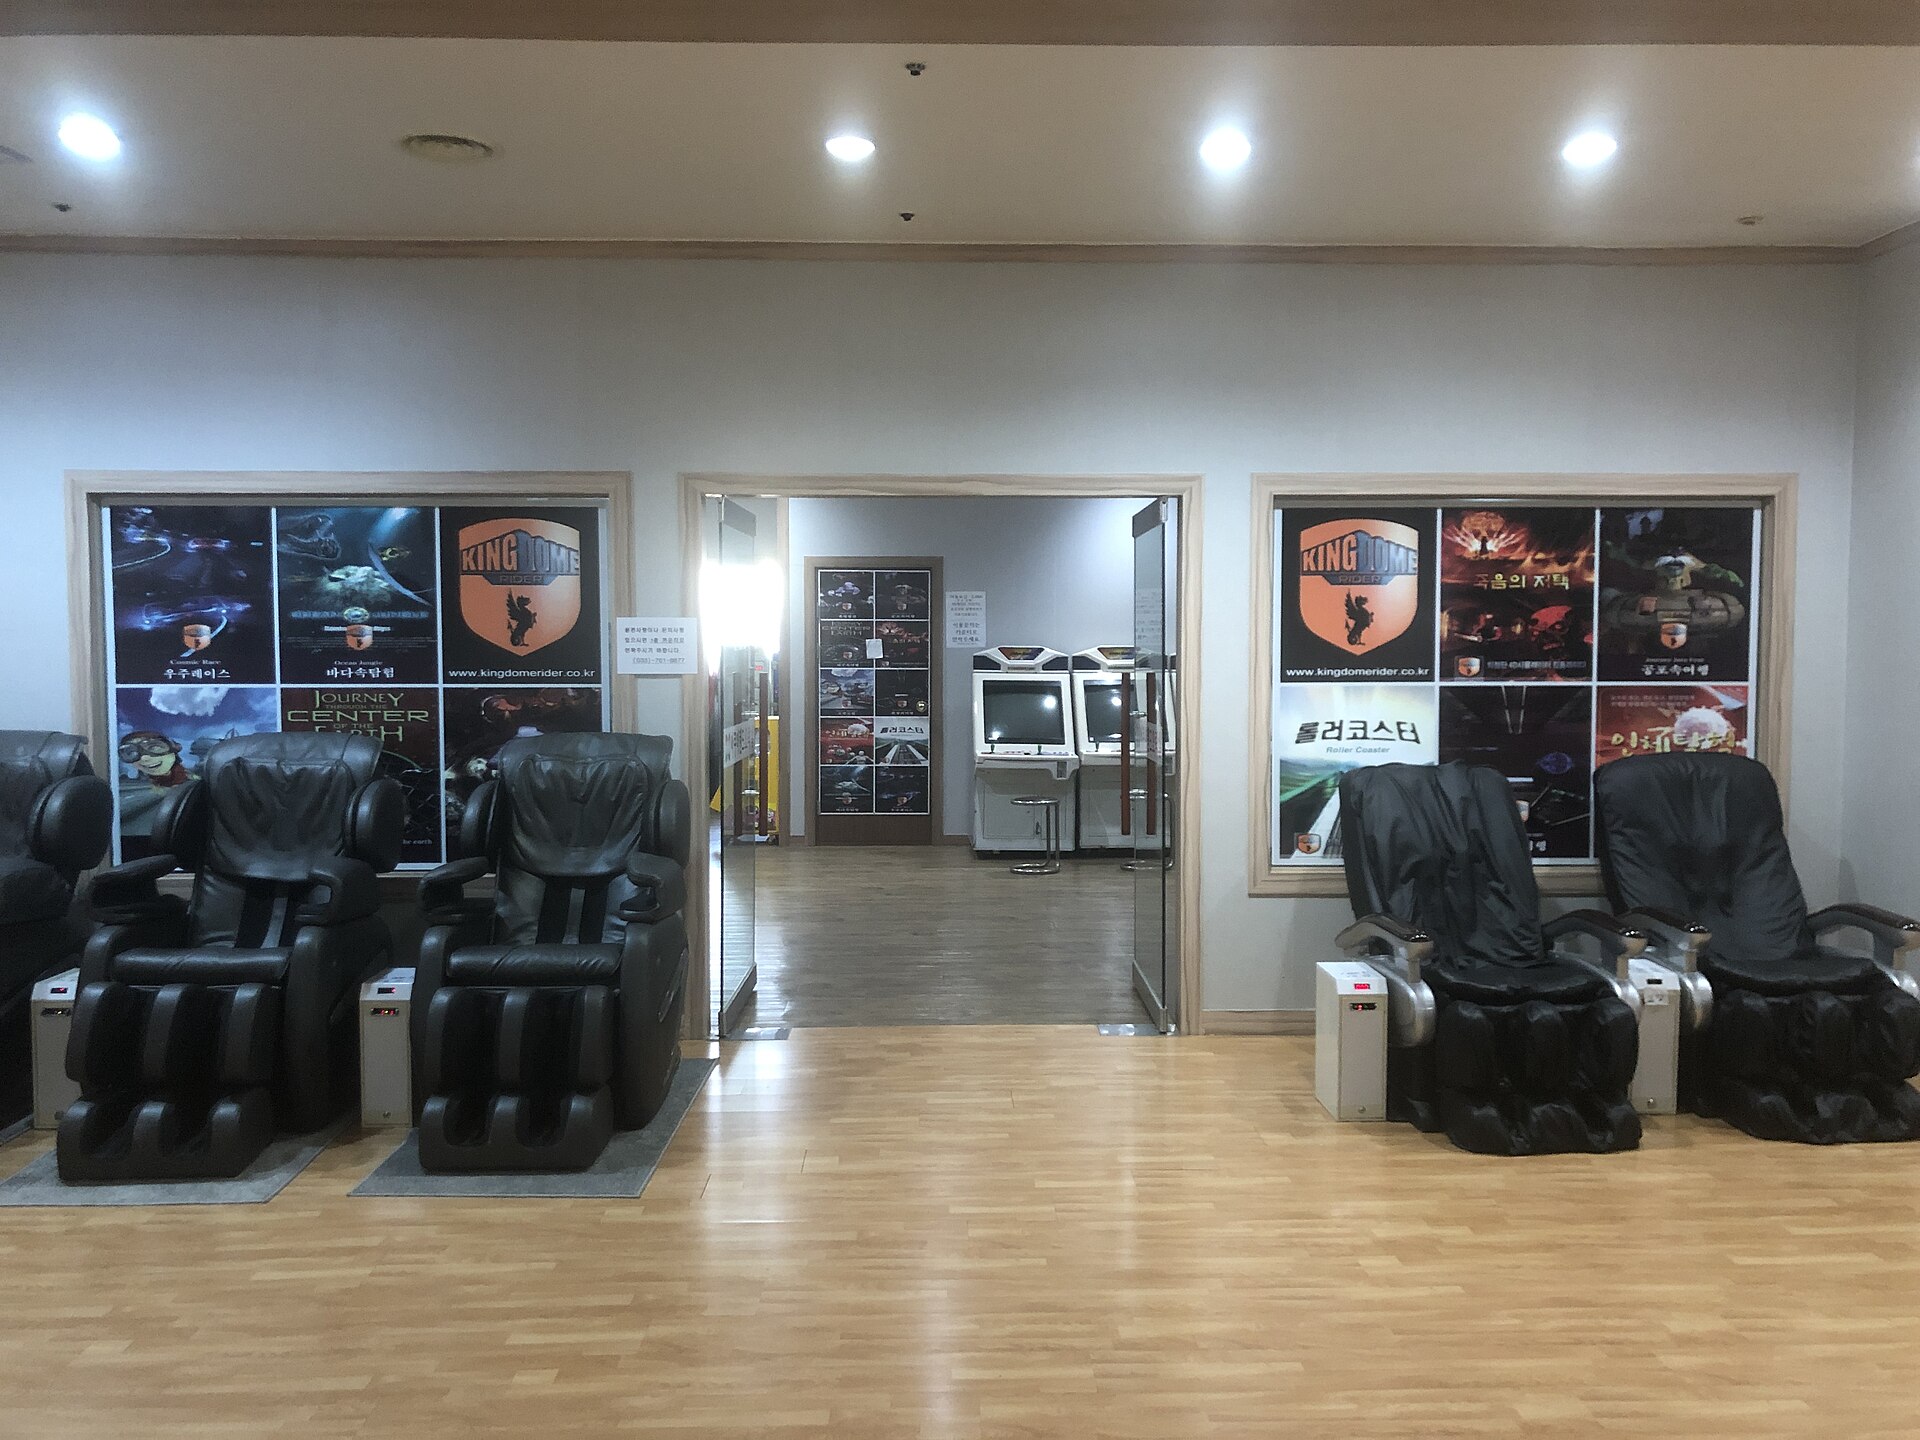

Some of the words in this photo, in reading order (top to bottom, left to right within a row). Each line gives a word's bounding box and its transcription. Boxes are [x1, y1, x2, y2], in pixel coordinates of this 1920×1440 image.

[462, 531, 579, 572] KINGDOME
[1302, 531, 1417, 573] KINGDOME
[499, 575, 543, 584] RIDER
[1338, 574, 1381, 583] RIDER
[1473, 573, 1526, 590] 죽음의
[1533, 573, 1570, 590] 저택
[163, 668, 231, 679] 우주레이스
[326, 667, 395, 679] 바다속탐험
[448, 668, 596, 679] www.kingdomerider.co.kr
[1286, 667, 1430, 678] www.kingdomerider.co.kr
[315, 690, 404, 708] JOURNEY
[287, 710, 429, 723] CENTER
[880, 726, 924, 734] 롤러코스터
[1294, 719, 1421, 745] 롤러코스터
